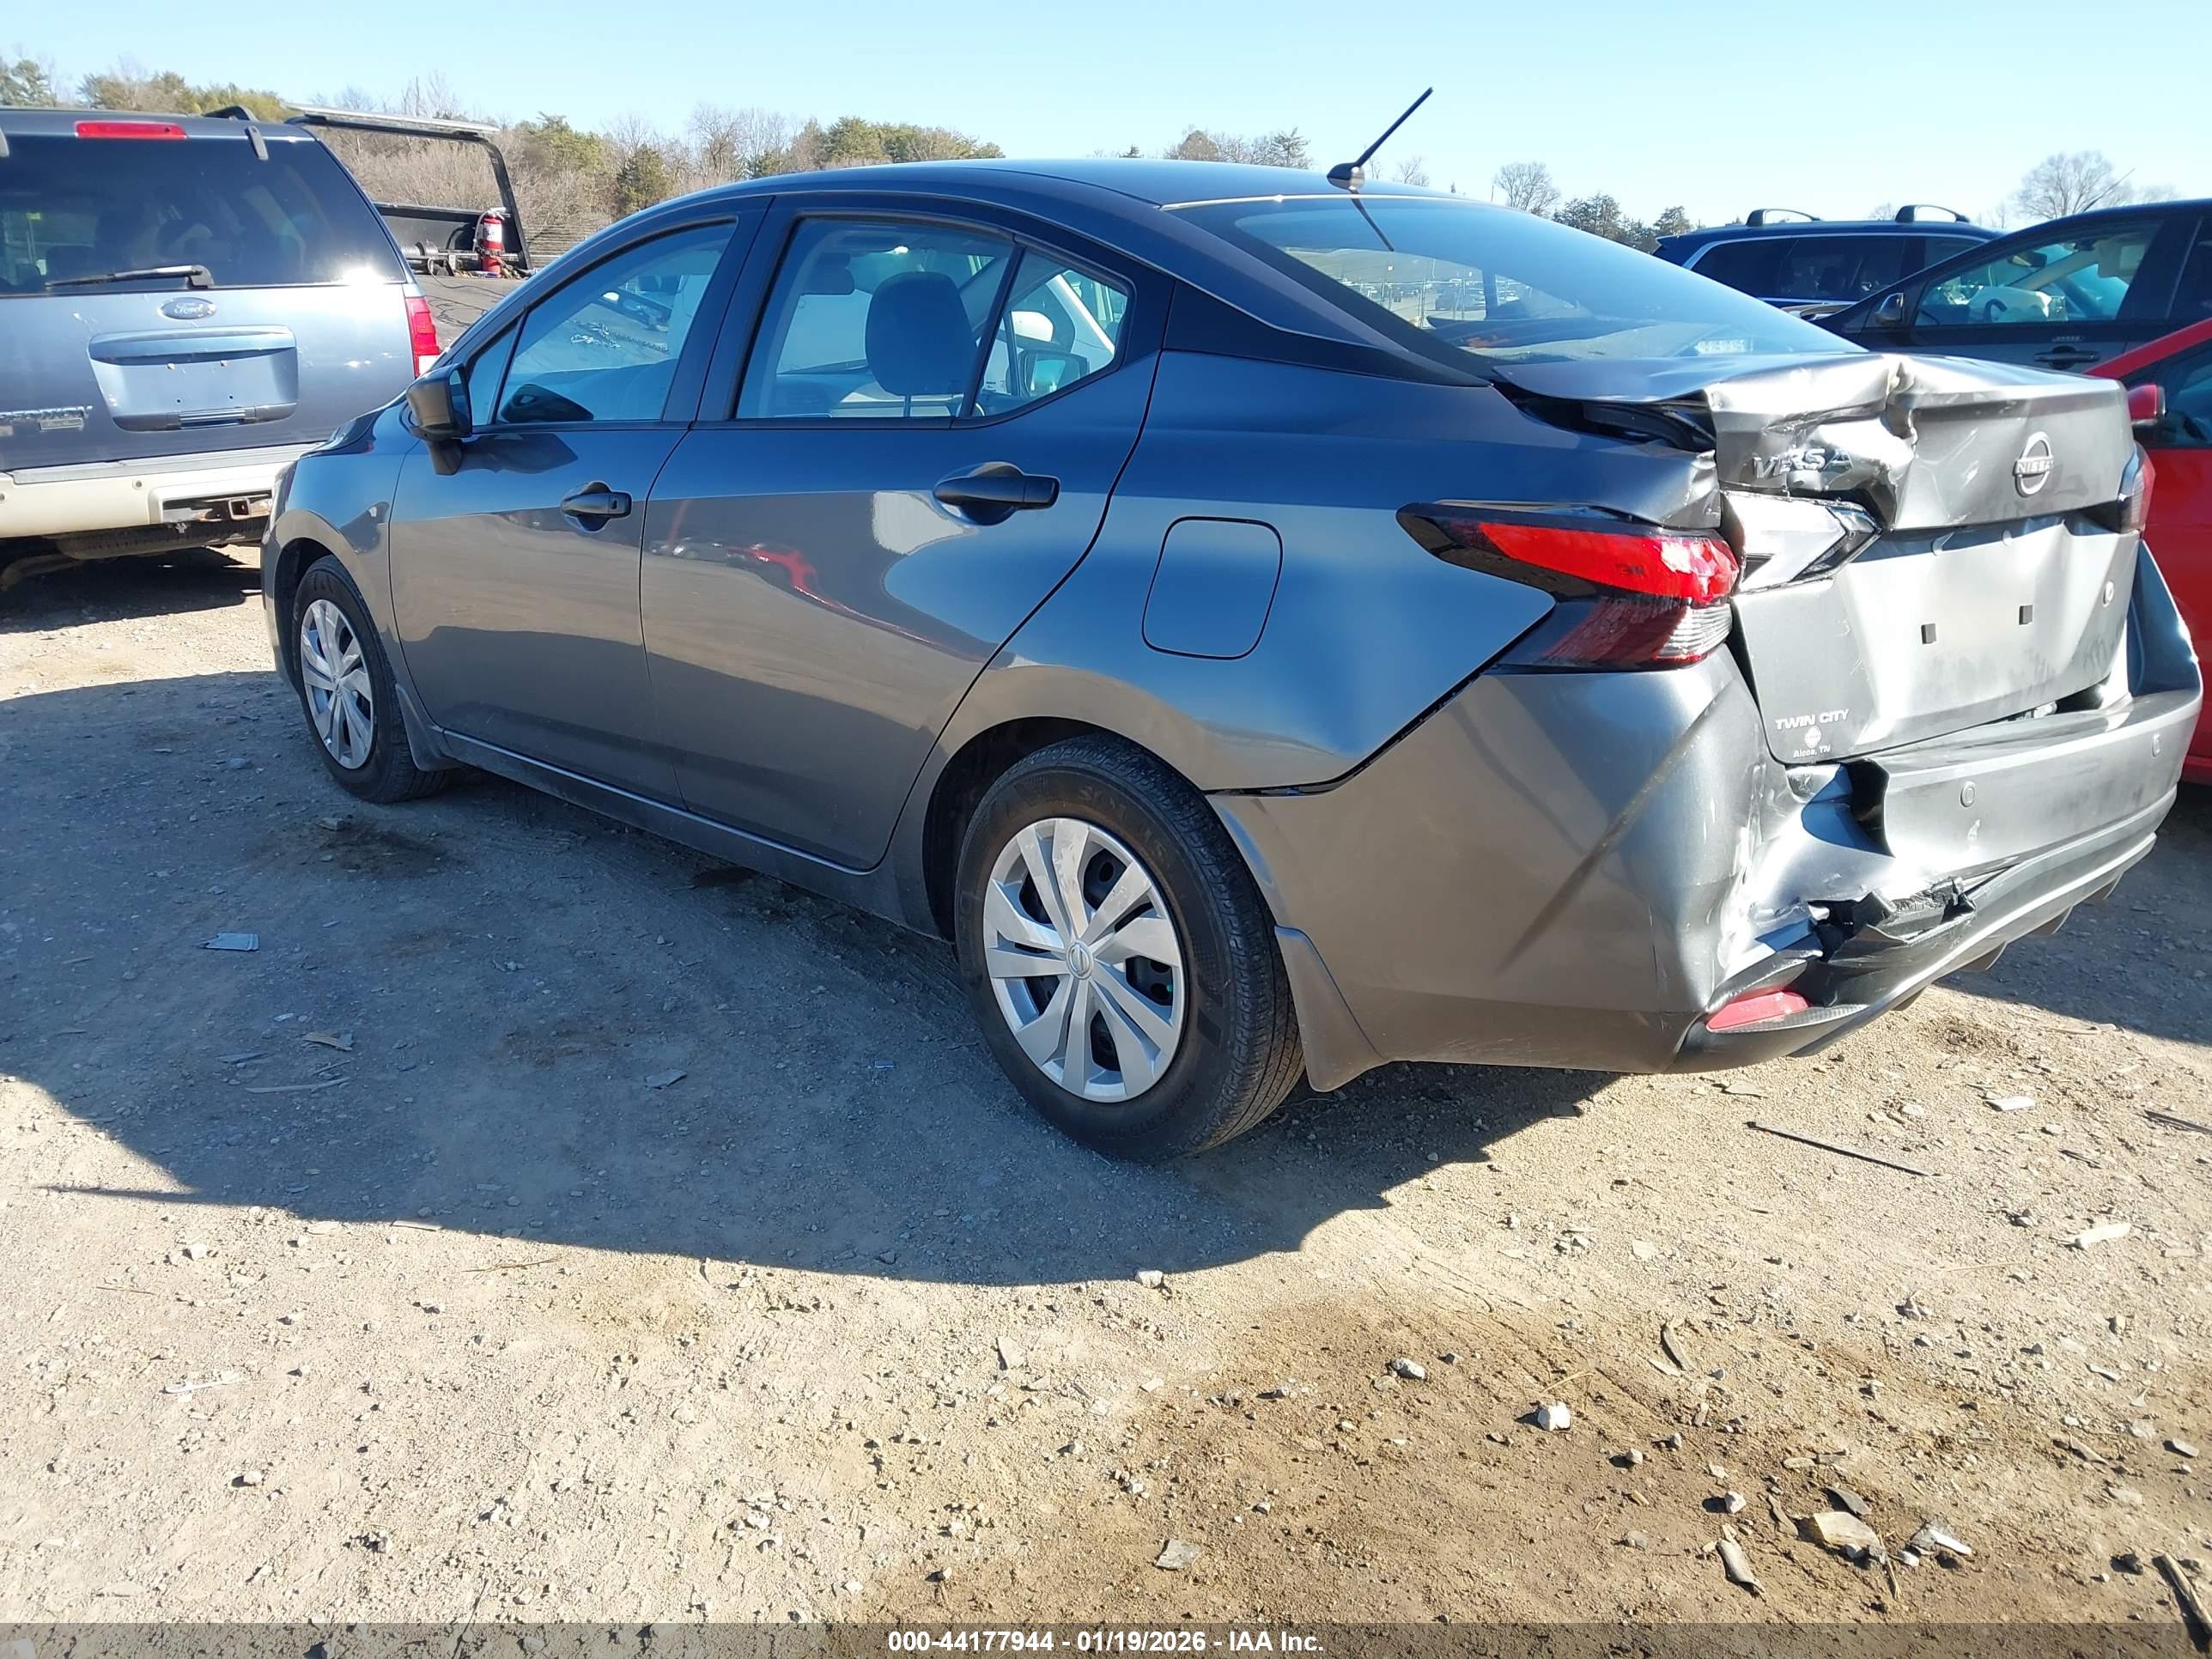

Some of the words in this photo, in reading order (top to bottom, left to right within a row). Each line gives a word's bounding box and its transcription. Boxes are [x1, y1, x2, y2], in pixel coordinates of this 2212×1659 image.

[173, 301, 204, 315] Ford
[1752, 447, 1854, 479] VERSA
[2015, 458, 2054, 474] NISSAN
[1774, 714, 1816, 730] TWIN
[1819, 708, 1850, 724] CITY
[1819, 744, 1831, 754] TN
